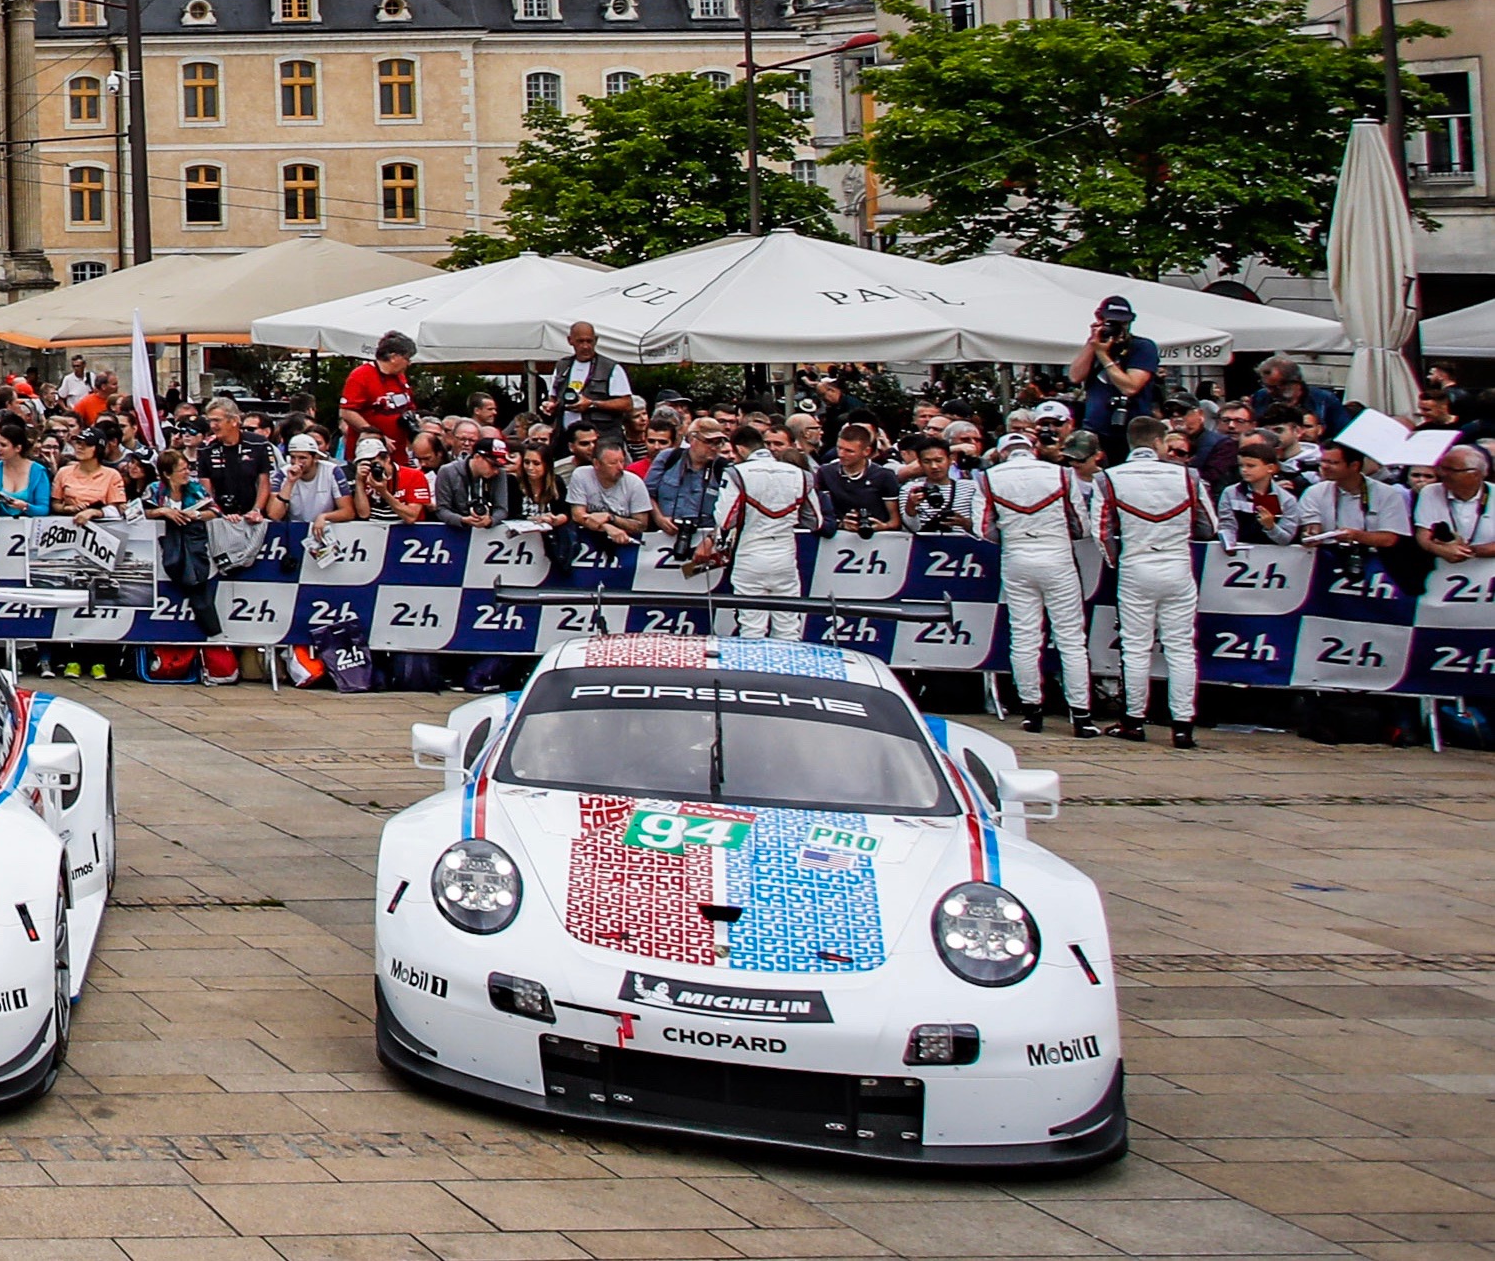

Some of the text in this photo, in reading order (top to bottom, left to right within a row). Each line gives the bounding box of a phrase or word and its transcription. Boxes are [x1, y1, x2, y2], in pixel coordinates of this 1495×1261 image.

[818, 285, 966, 306] PAUL
[1185, 345, 1222, 358] 1889
[81, 525, 115, 563] Thor
[400, 539, 451, 564] 24h
[484, 541, 535, 565] 24h
[833, 549, 888, 574] 24h
[925, 551, 983, 578] 24h
[1223, 561, 1286, 589] 24h
[150, 597, 195, 621] 24h
[228, 598, 276, 622] 24h
[391, 603, 440, 628] 24h
[472, 605, 524, 630] 24h
[642, 610, 696, 634] 24h
[821, 616, 876, 642] 24h
[336, 645, 364, 665] 24h
[1212, 633, 1276, 661] 24h
[1317, 637, 1383, 667] 24h
[571, 685, 868, 717] PORSCHE
[684, 807, 751, 821] TOTAL
[637, 813, 733, 849] 94
[813, 826, 878, 851] PRO
[390, 958, 448, 999] Mobil 1
[12, 988, 29, 1009] 1
[675, 990, 811, 1014] MICHELIN
[663, 1027, 787, 1053] CHOPARD
[1027, 1035, 1101, 1066] Mobil 1
